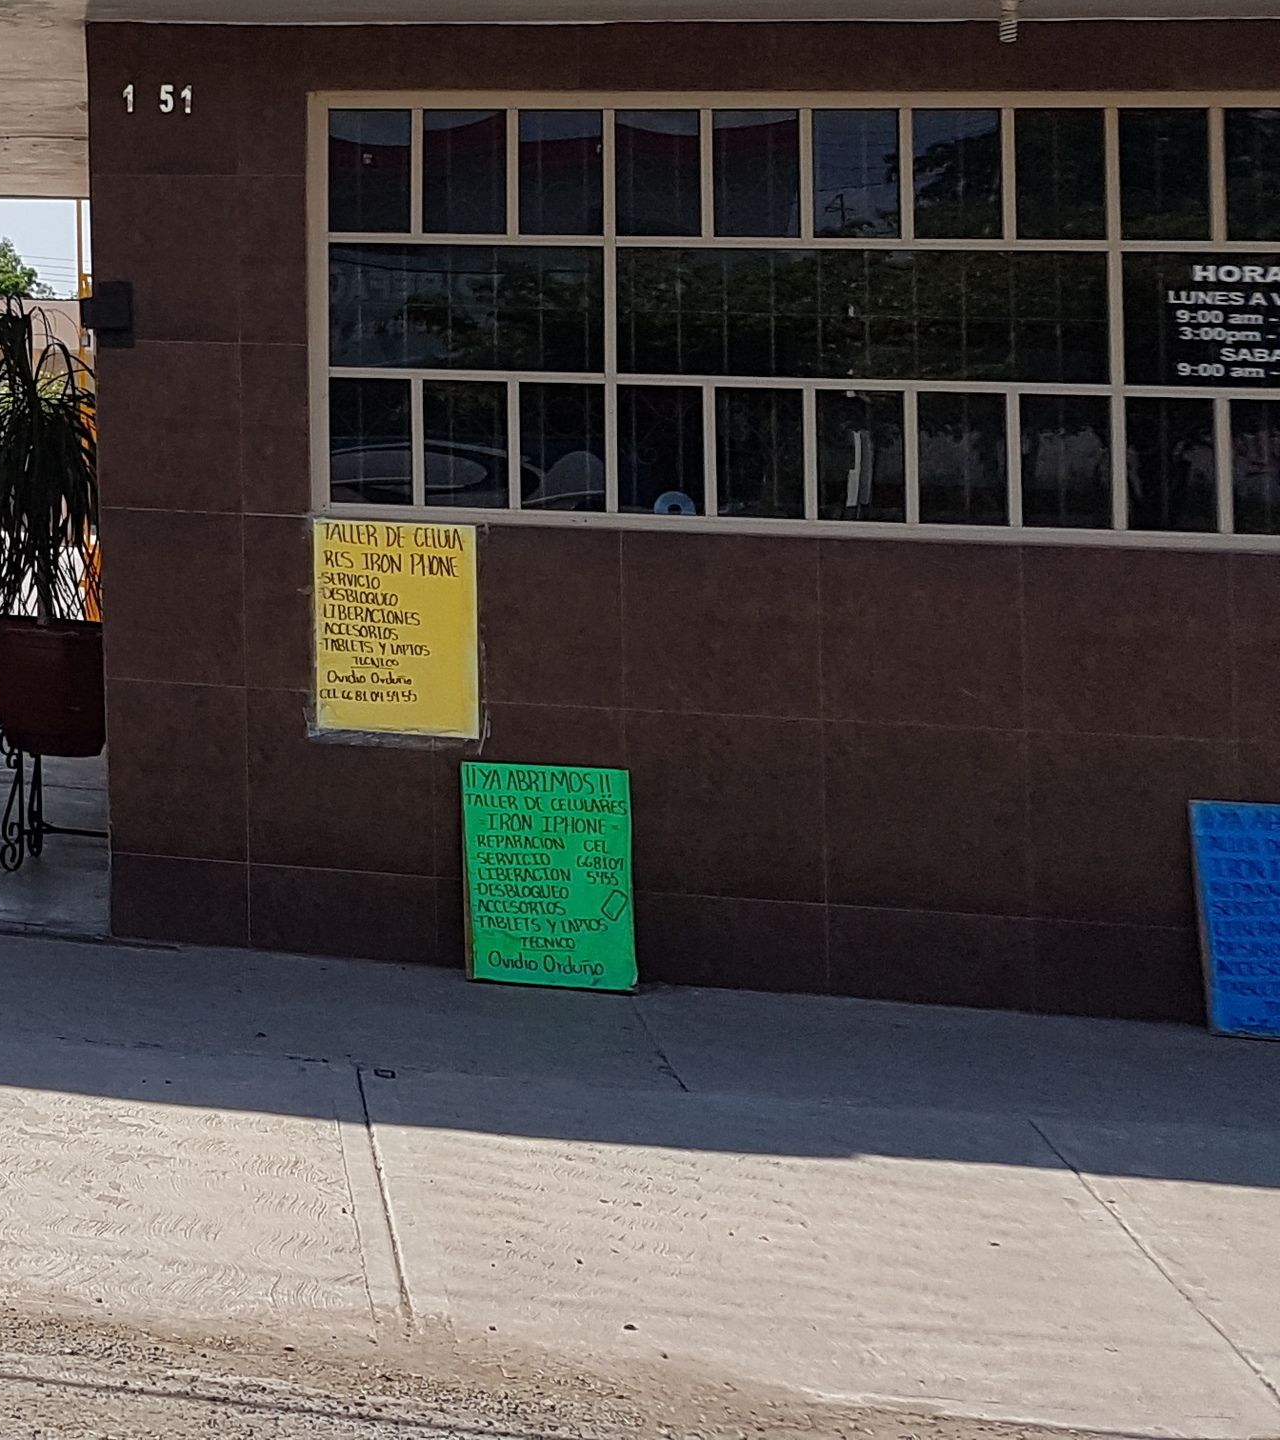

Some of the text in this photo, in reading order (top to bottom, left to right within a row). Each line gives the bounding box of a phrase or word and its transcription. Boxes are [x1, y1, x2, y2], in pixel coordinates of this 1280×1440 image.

[1167, 290, 1245, 306] LUNES
[1247, 292, 1269, 306] A
[1175, 310, 1225, 324] 9:00
[1227, 313, 1265, 324] am
[1176, 362, 1226, 377] 9:00
[1229, 366, 1266, 378] am
[322, 521, 378, 548] TALLER
[385, 526, 407, 549] DE
[323, 549, 460, 578] RES IRON PHONE
[378, 641, 386, 656] Y
[319, 688, 339, 700] CEL
[354, 689, 368, 702] 81
[465, 792, 628, 816] TALLER DE CELULARES
[583, 839, 609, 854] CEL
[546, 919, 557, 934] Y
[488, 949, 539, 971] Ovidio
